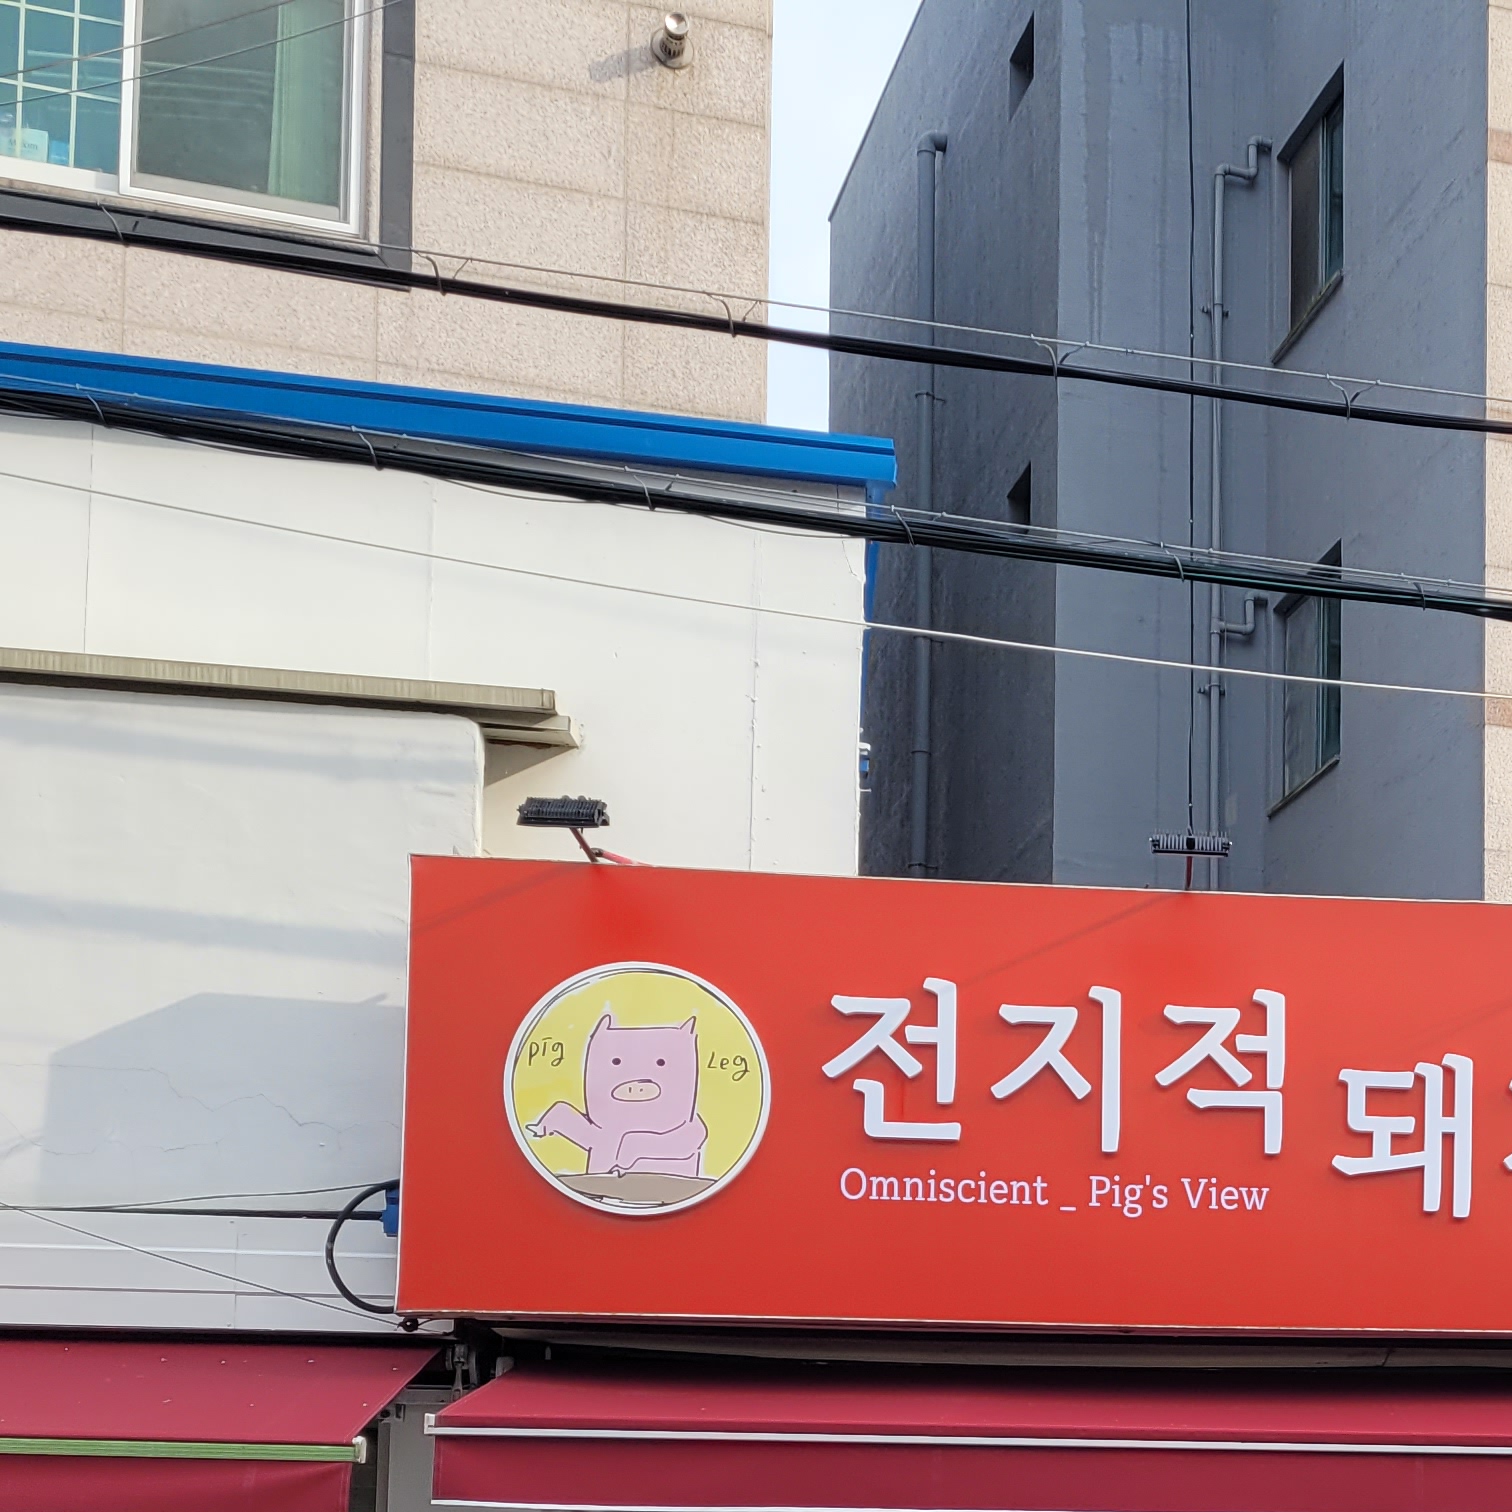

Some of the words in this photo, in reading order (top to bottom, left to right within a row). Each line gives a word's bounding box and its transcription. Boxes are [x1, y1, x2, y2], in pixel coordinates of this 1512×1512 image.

[821, 977, 1287, 1156] 전지적
[840, 1167, 1049, 1206] Omniscient
[1088, 1174, 1169, 1218] Pig's
[1180, 1177, 1270, 1211] View
